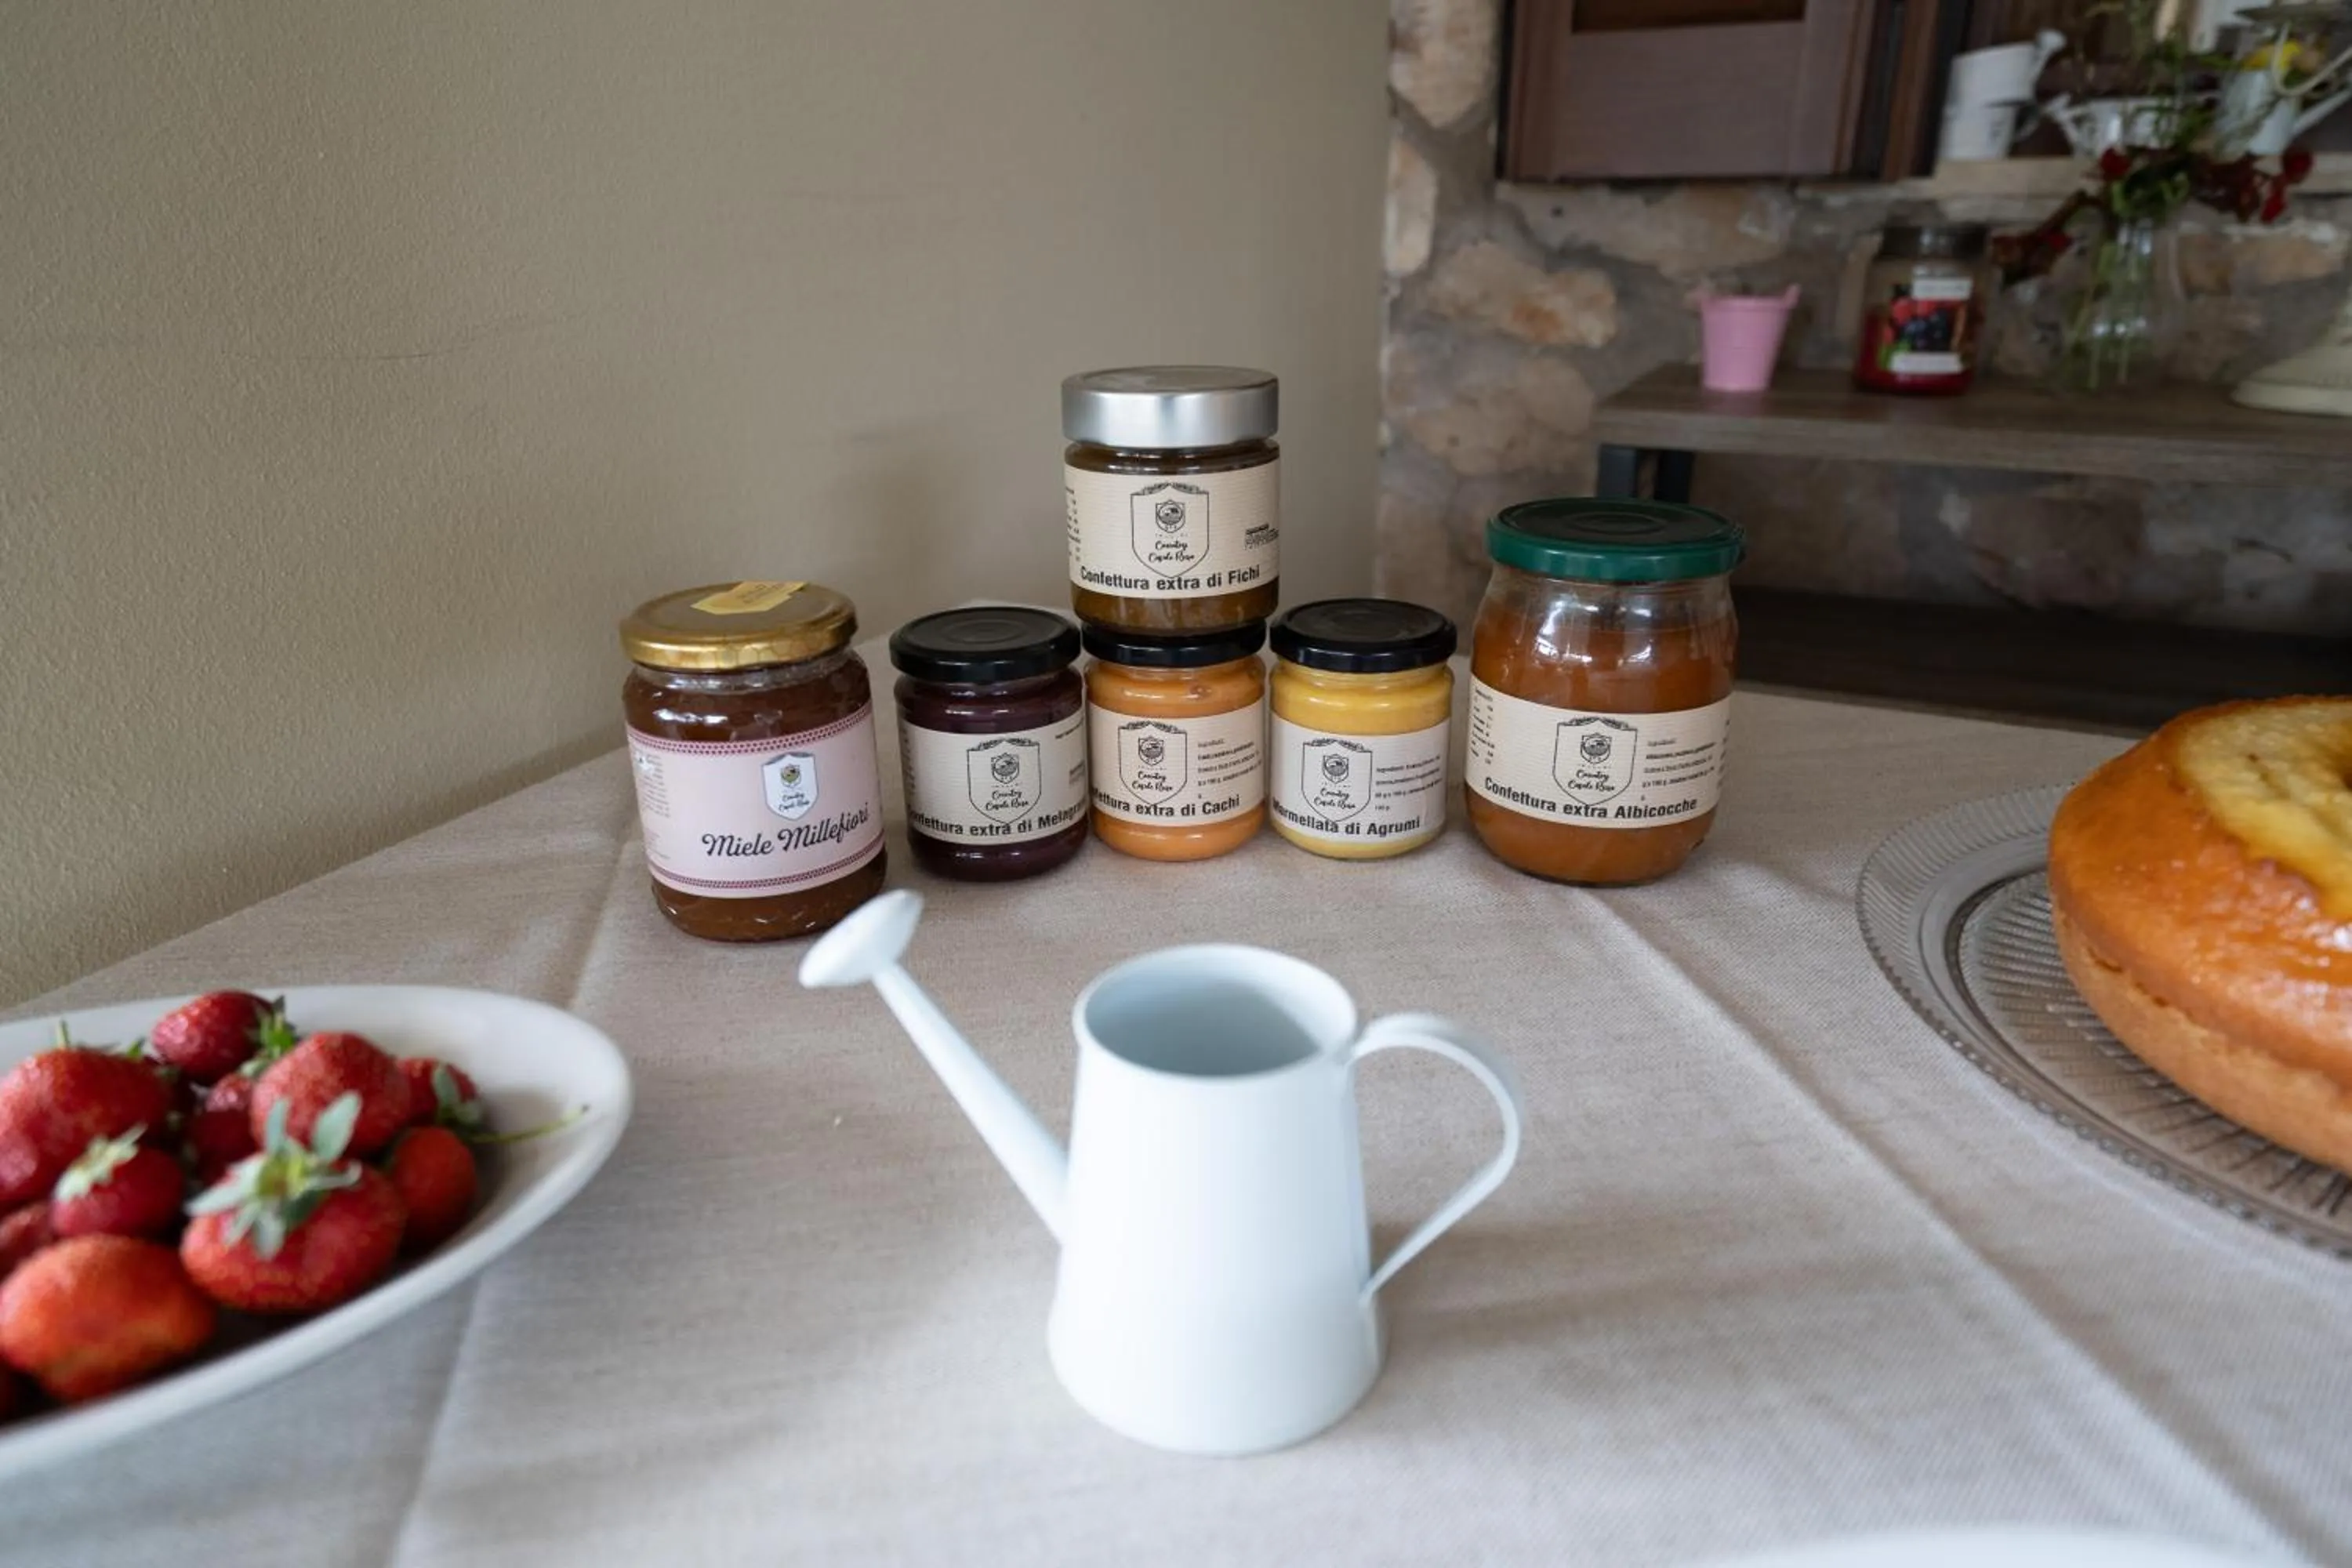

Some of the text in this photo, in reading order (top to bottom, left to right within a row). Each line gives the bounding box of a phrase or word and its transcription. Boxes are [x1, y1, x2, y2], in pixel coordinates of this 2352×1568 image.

[1080, 564, 1261, 590] Confettura extra di Fichi
[1136, 803, 1175, 816] extra
[1181, 804, 1196, 816] di
[1202, 794, 1240, 815] Cachi
[1484, 777, 1697, 818] Confettura extra Albicocche
[702, 833, 775, 858] Miele
[777, 802, 869, 851] Millefiori
[970, 824, 1011, 837] extra
[1017, 822, 1033, 833] di
[1272, 797, 1421, 837] Marmellata di Agrumi
